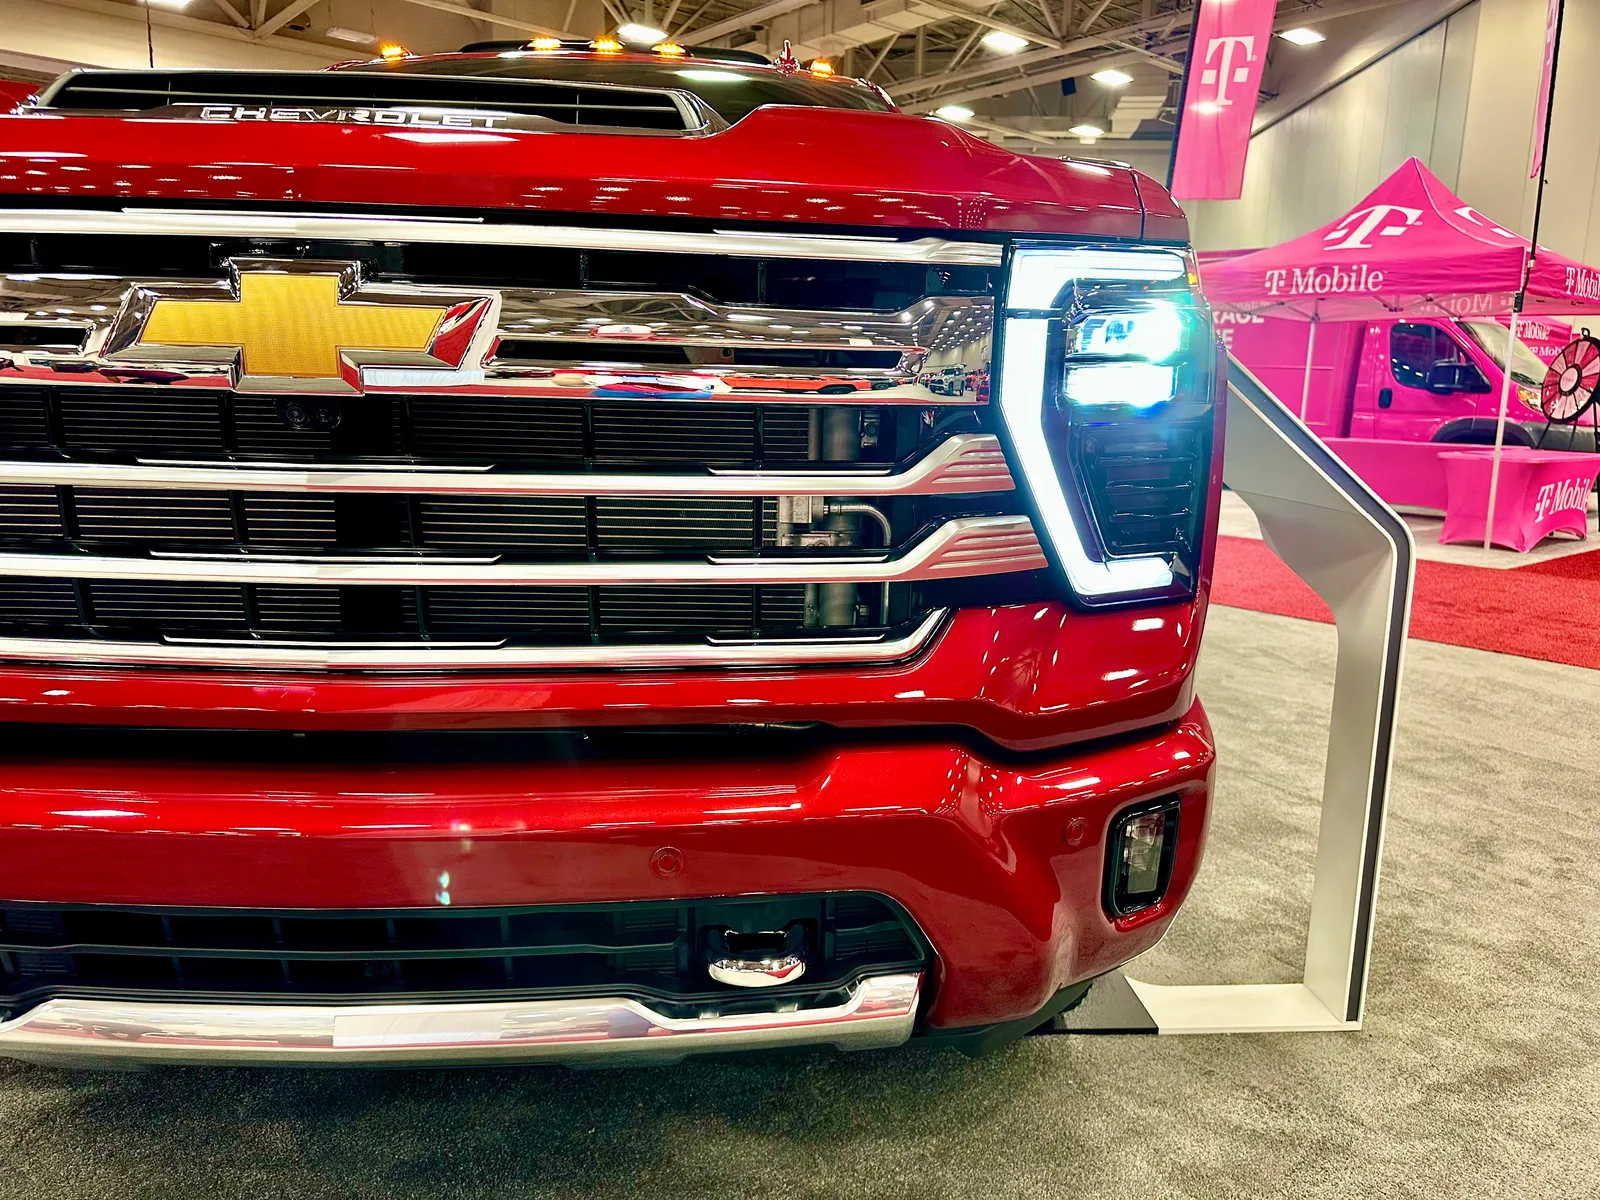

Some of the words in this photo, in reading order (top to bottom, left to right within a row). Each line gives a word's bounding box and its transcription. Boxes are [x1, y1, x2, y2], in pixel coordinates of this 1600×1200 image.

[1201, 36, 1255, 106] T
[200, 105, 508, 128] CHEVROLET
[1323, 205, 1424, 251] T
[1289, 264, 1384, 295] Mobile
